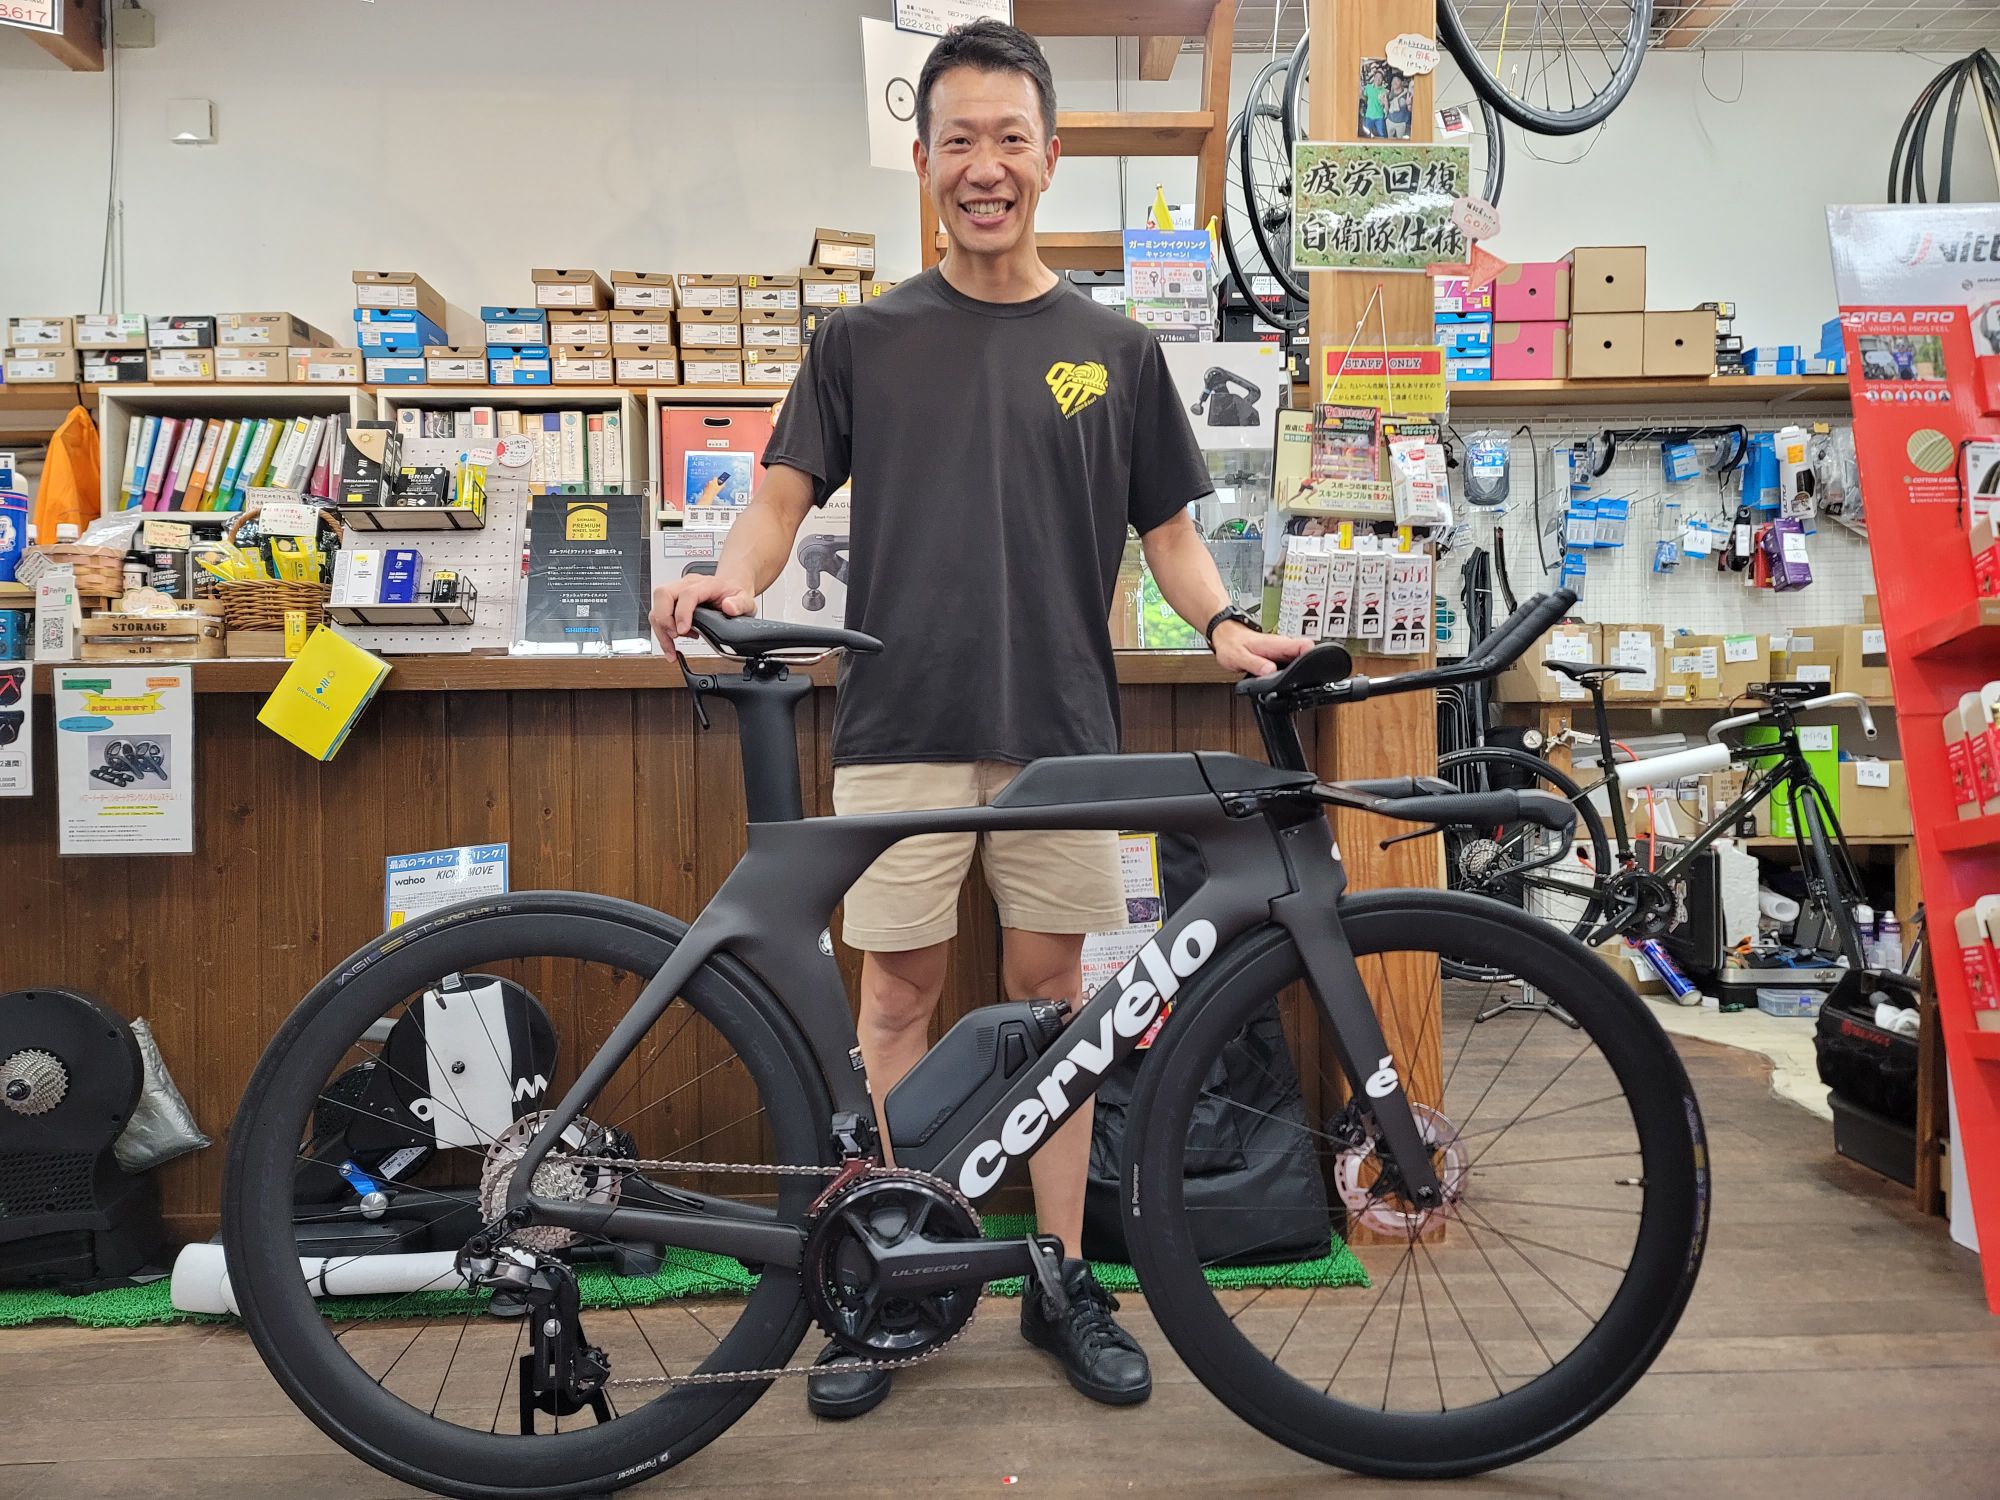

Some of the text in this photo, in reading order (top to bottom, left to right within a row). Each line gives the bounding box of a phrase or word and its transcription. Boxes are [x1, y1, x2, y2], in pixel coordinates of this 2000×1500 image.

[1302, 160, 1461, 199] 疲労回復
[1302, 213, 1467, 254] 自衛隊仕様
[1129, 240, 1206, 249] ガーミンサイクリング
[1912, 311, 1955, 323] PRO
[1344, 358, 1421, 369] STAFF ONLY
[112, 623, 168, 631] STORAGE
[394, 876, 425, 887] wahoo
[338, 922, 434, 986] AGILEST
[958, 919, 1218, 1199] cervélo
[891, 1263, 970, 1278] ULTEGRA
[616, 1458, 658, 1480] Panaracer
